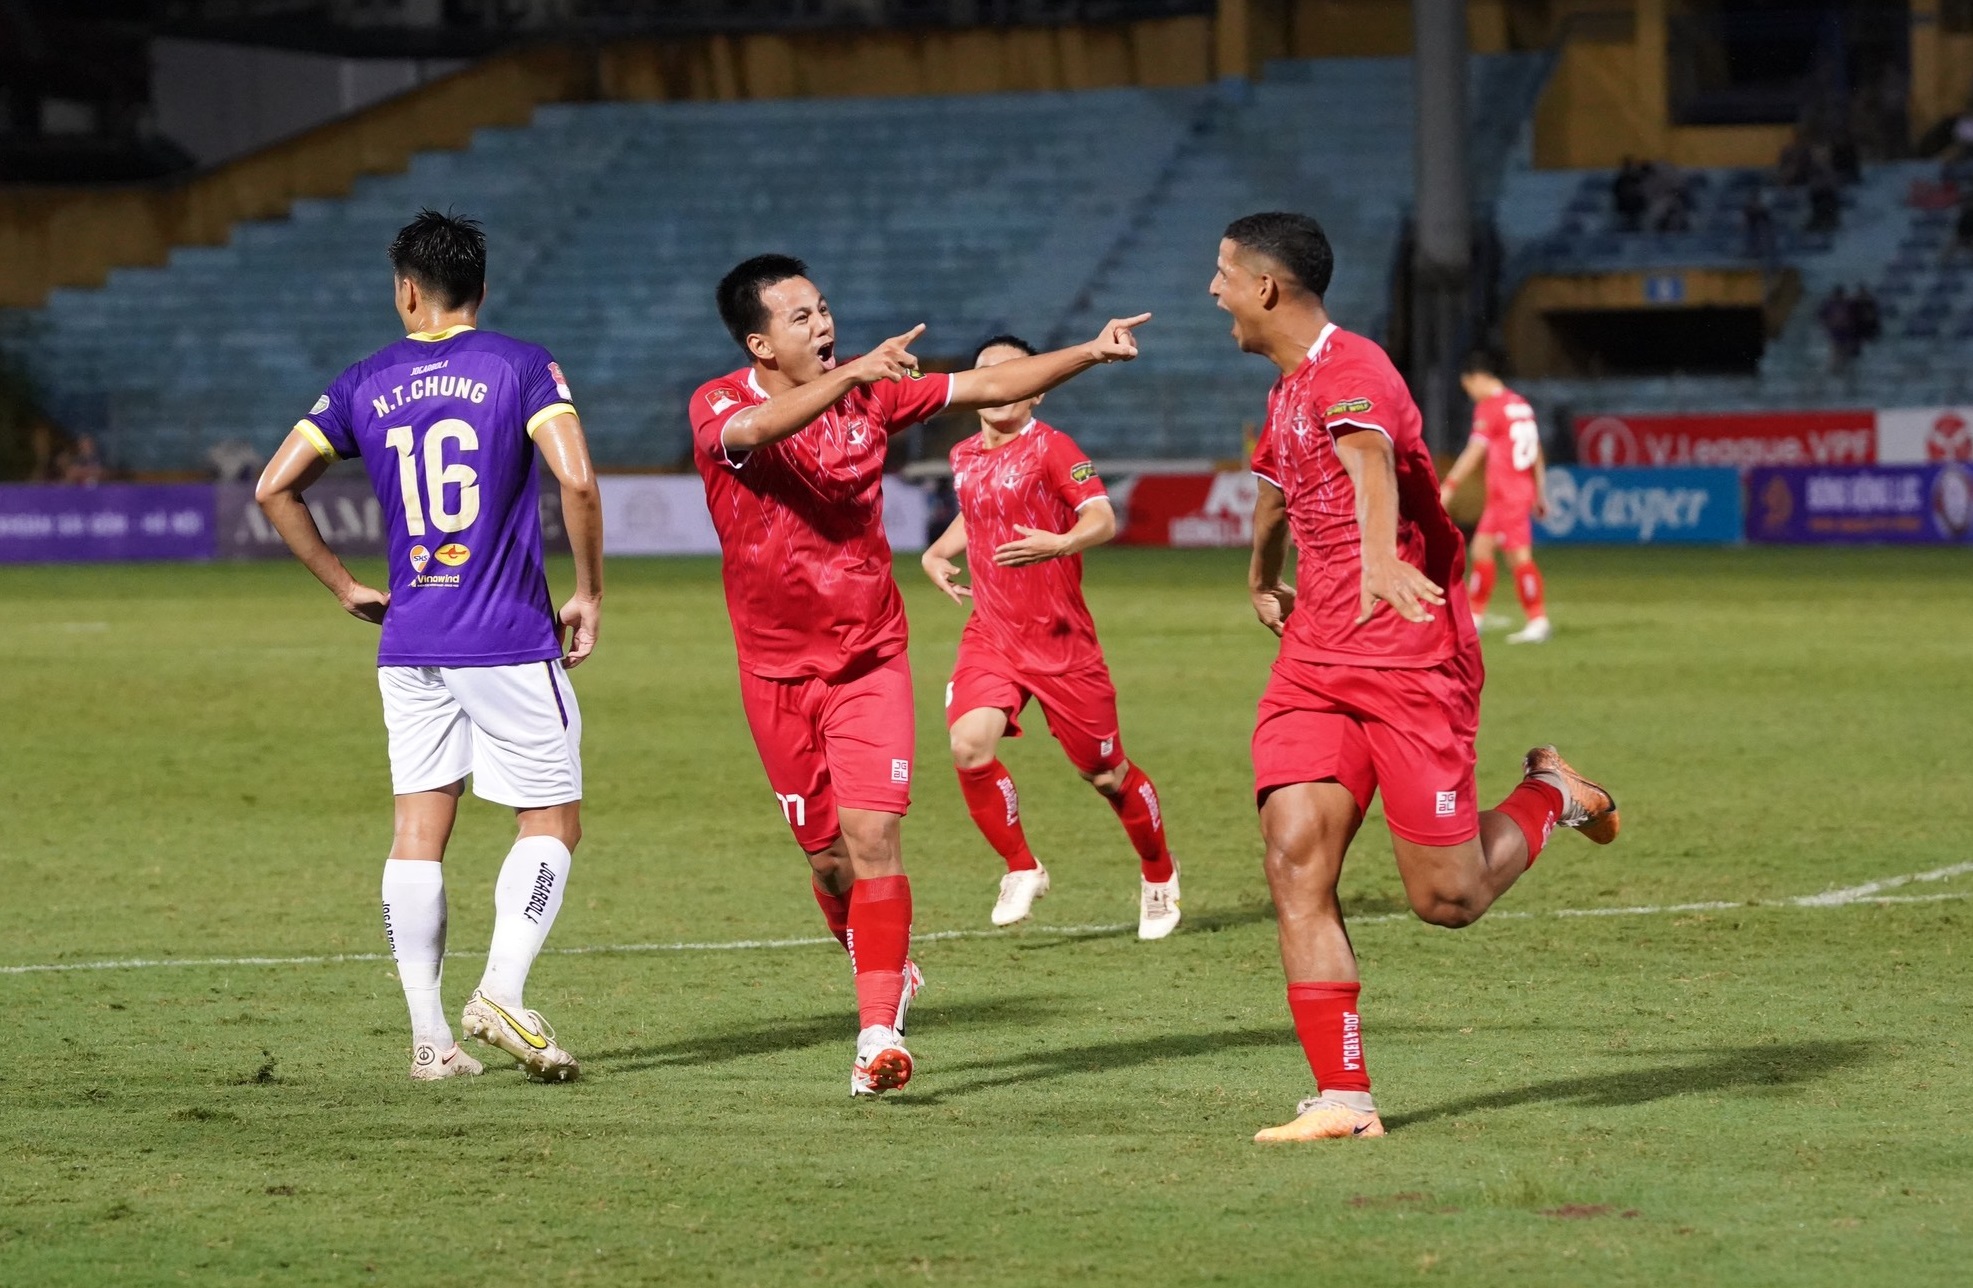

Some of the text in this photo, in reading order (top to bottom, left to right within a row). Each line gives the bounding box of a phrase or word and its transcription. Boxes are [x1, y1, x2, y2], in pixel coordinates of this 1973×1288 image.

[372, 375, 488, 418] N.T.CHUNG
[385, 418, 480, 536] 16
[1579, 476, 1709, 541] Casper
[523, 861, 556, 925] JOGARBOLA
[1343, 1011, 1362, 1071] JOGARBOLA
